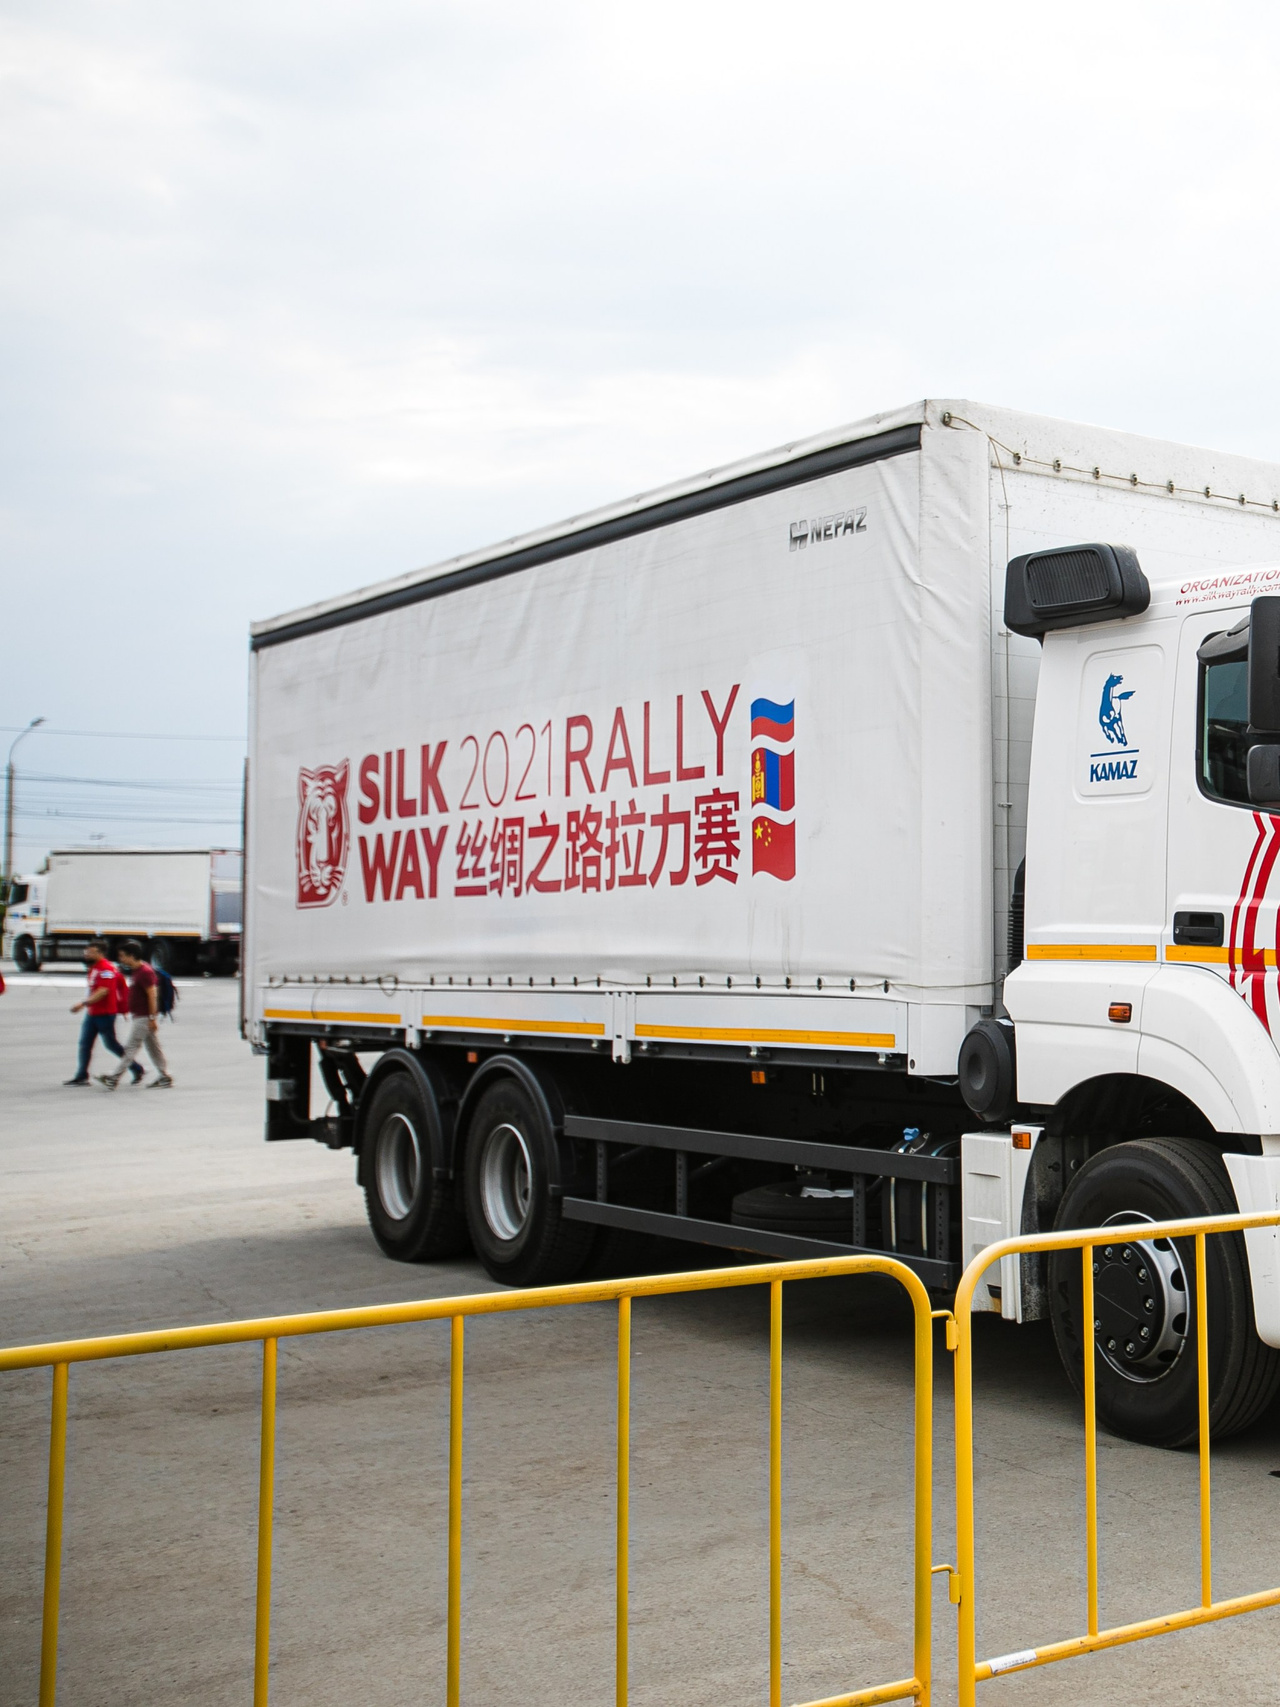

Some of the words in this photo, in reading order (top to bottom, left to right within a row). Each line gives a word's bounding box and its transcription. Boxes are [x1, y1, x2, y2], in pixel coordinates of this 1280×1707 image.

[809, 505, 868, 544] NEFAZ
[357, 739, 450, 826] SILK
[458, 719, 553, 811] 2021
[564, 683, 741, 799] RALLY
[1089, 759, 1138, 783] KAMAZ
[357, 823, 450, 904] WAY
[454, 786, 741, 899] 丝绸之路拉力赛
